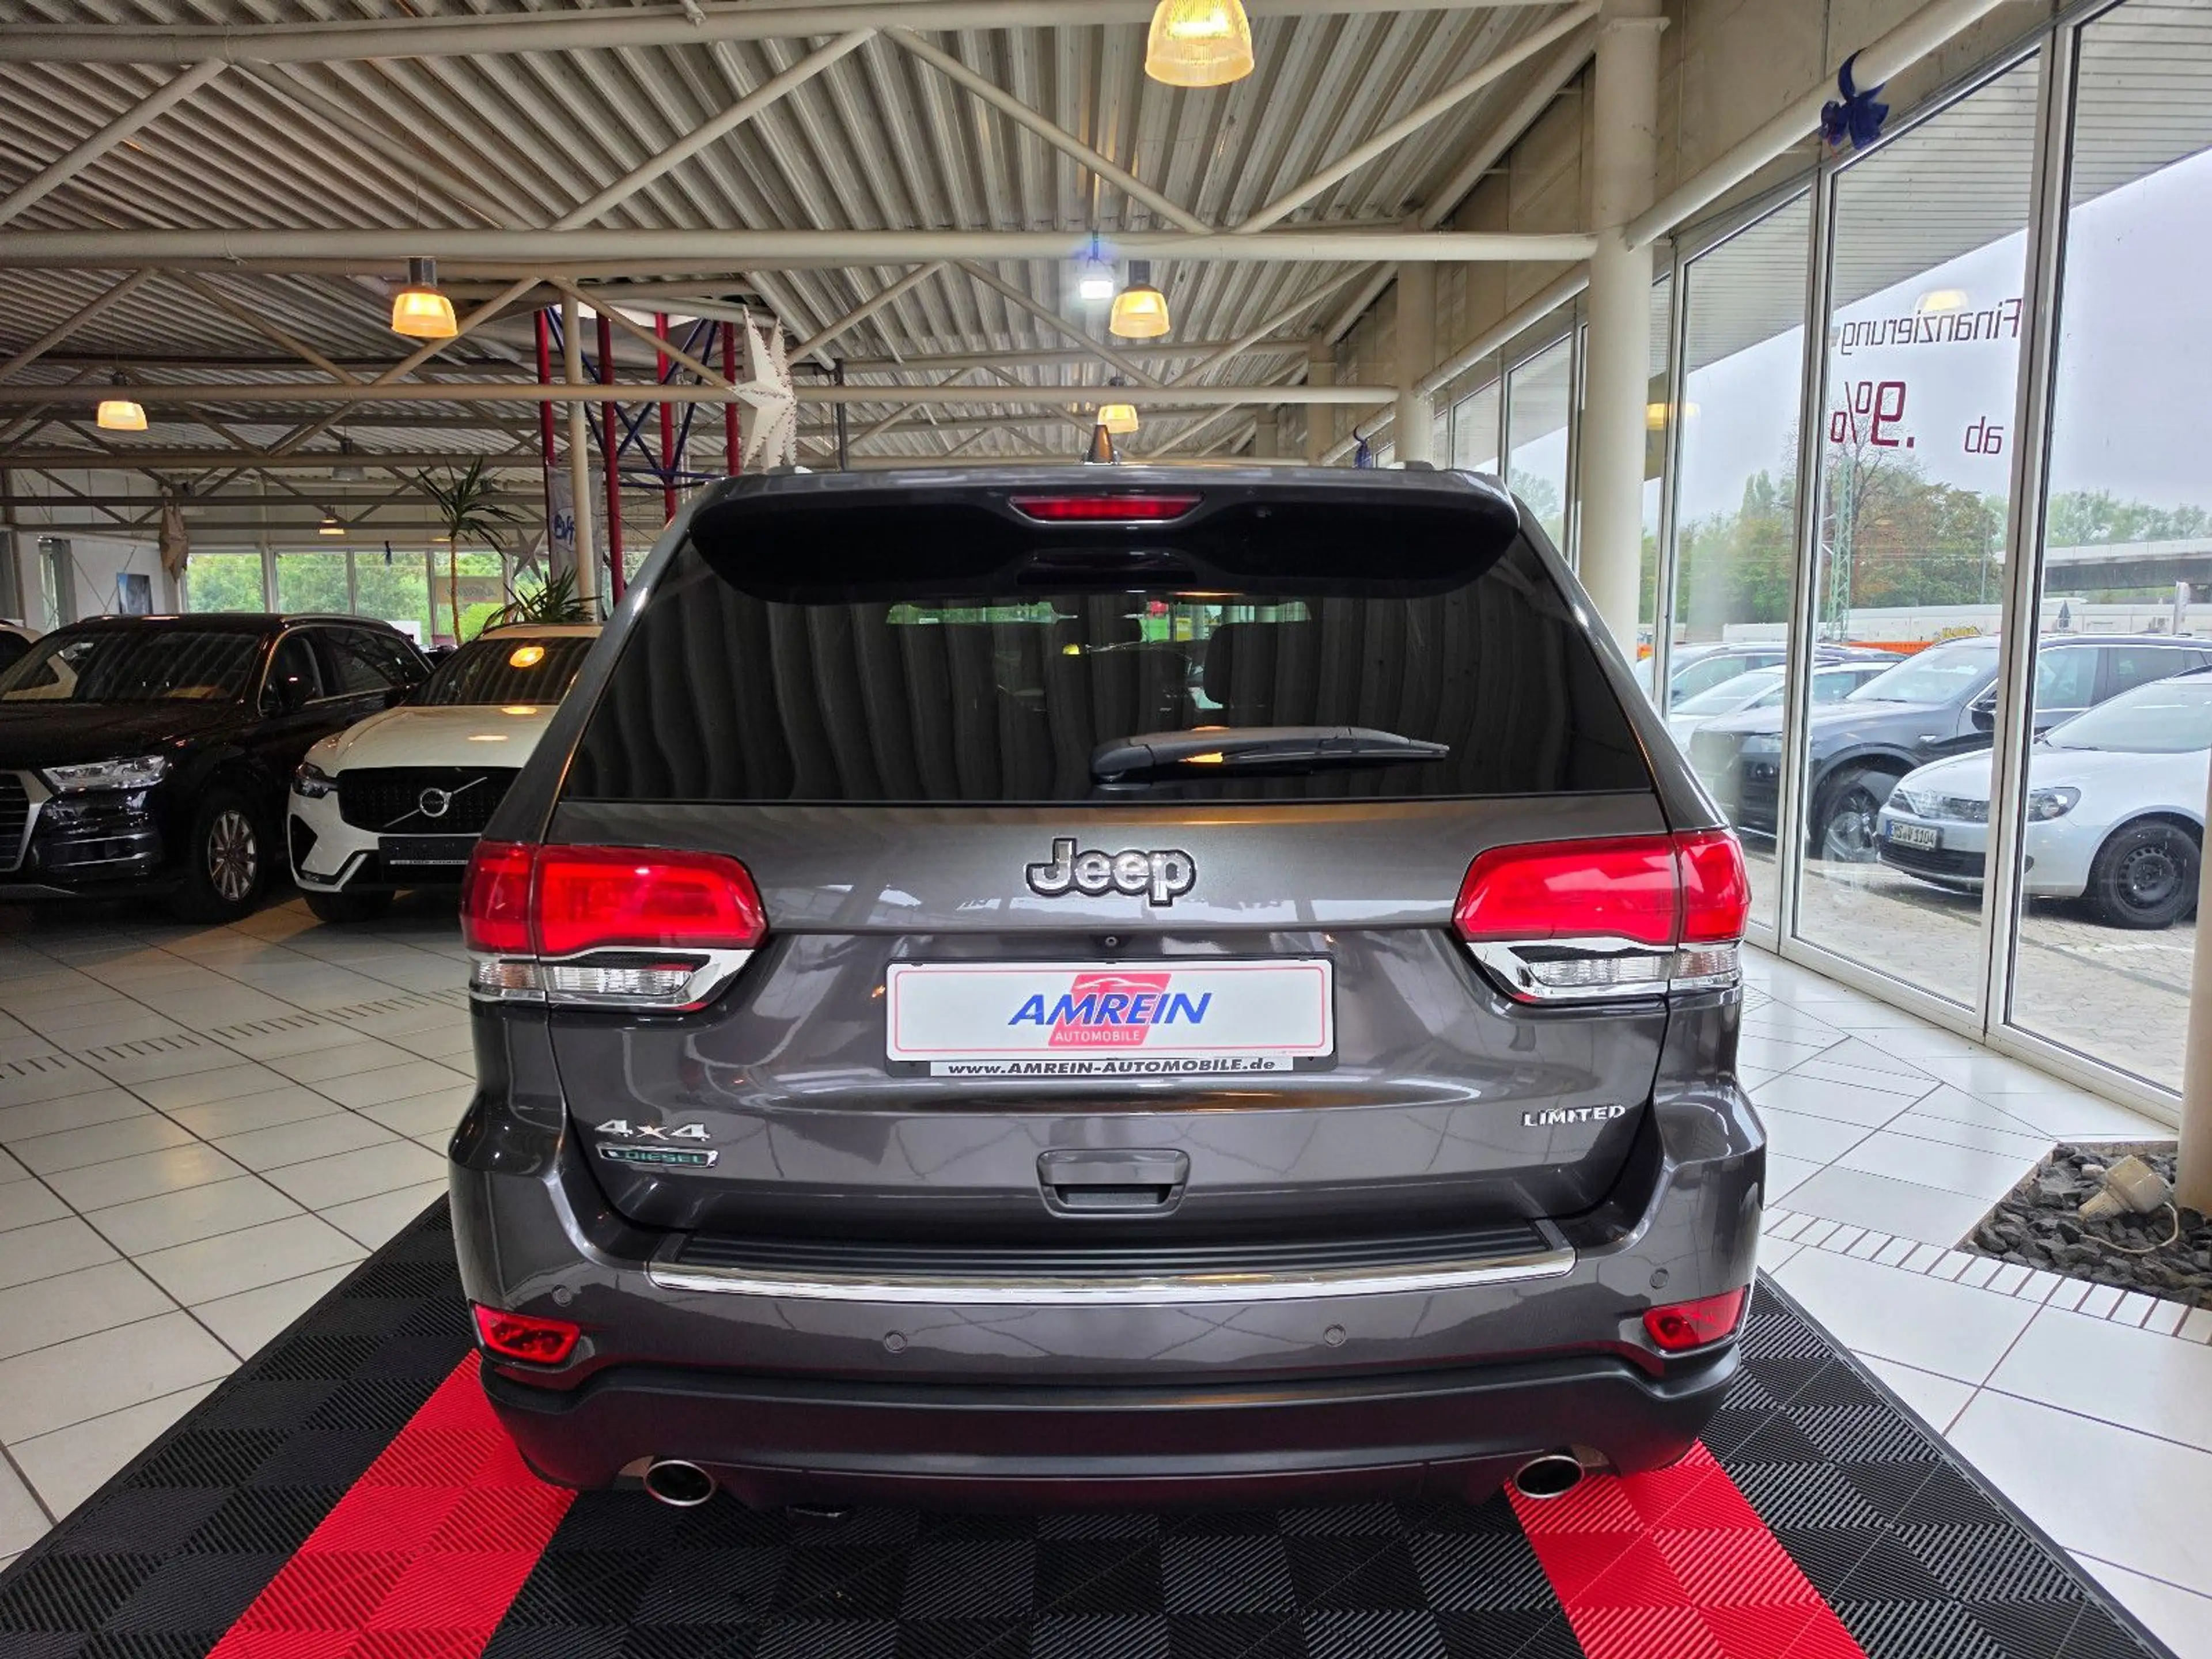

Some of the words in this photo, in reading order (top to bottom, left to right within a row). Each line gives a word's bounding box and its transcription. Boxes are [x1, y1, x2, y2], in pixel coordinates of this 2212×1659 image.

[1027, 838, 1196, 907] Jeep
[1008, 993, 1213, 1026] AMREIN
[1055, 1031, 1140, 1042] AUTOMOBILE
[948, 1058, 1275, 1074] www.AMREIN-AUTOMOBILE.de
[1523, 1104, 1626, 1127] LIMITED
[626, 1150, 704, 1164] DIESEL
